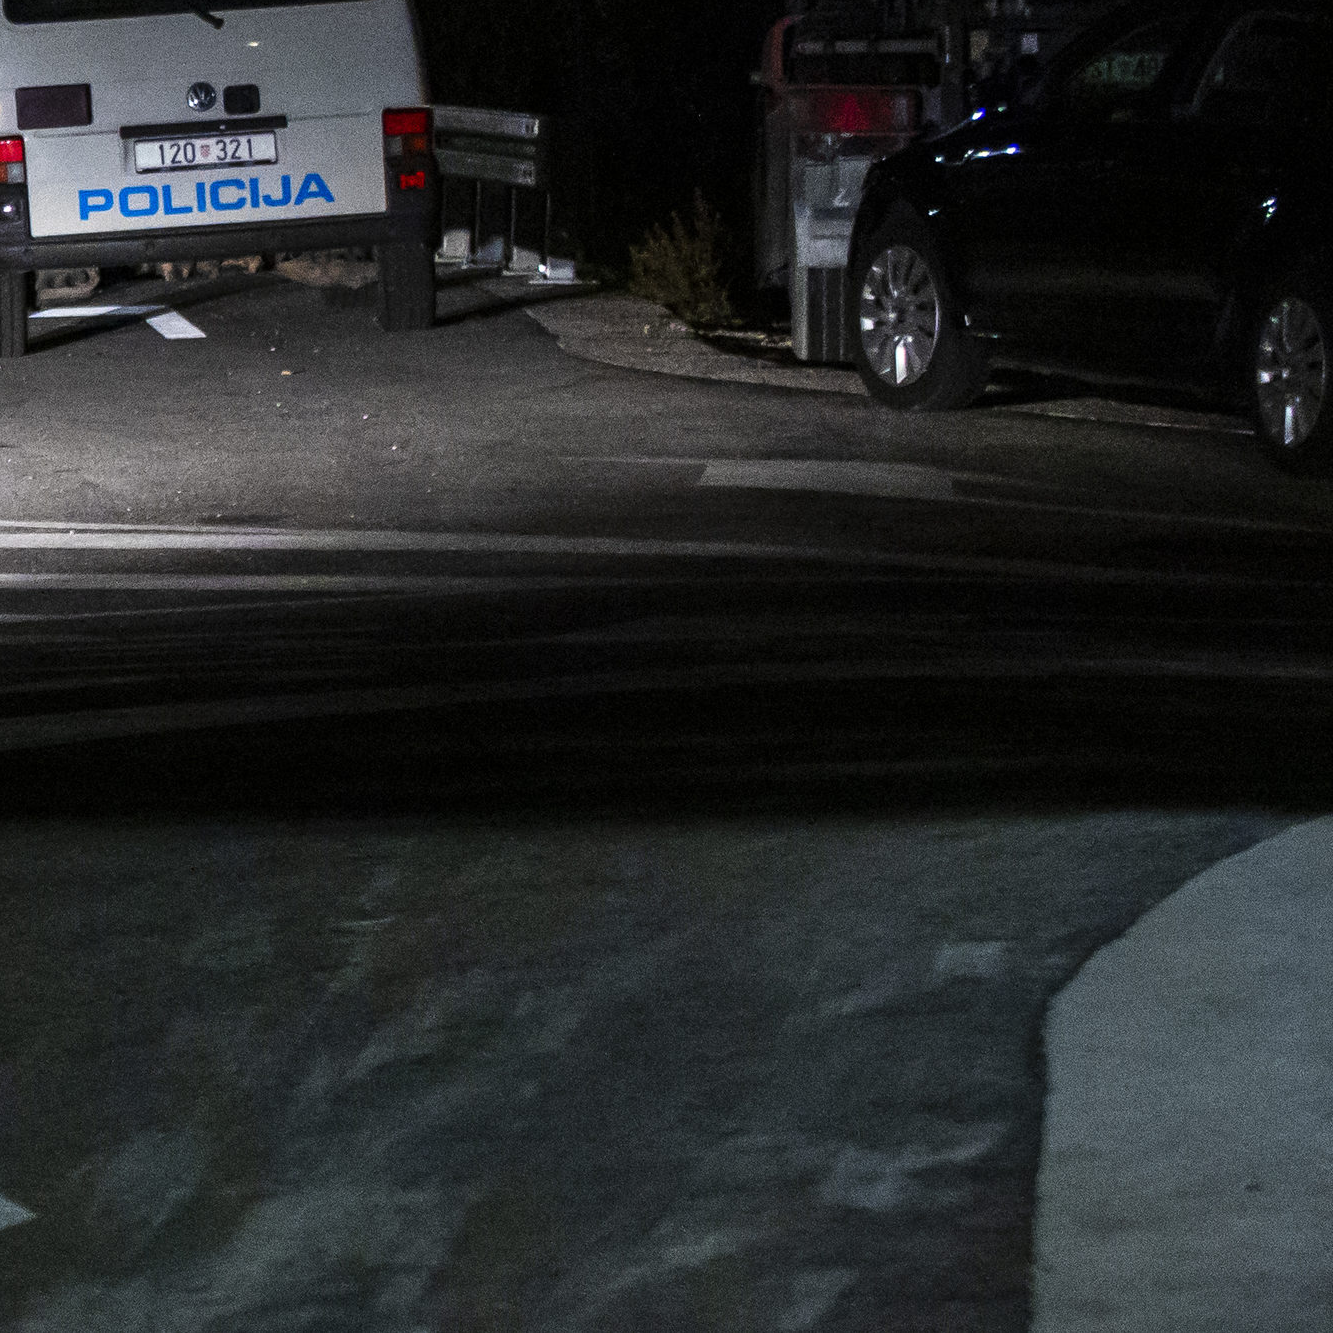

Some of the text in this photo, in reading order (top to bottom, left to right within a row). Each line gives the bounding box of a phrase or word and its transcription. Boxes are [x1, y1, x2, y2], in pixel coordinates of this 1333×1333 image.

[159, 138, 253, 165] 120 321
[78, 173, 335, 220] POLICIJA
